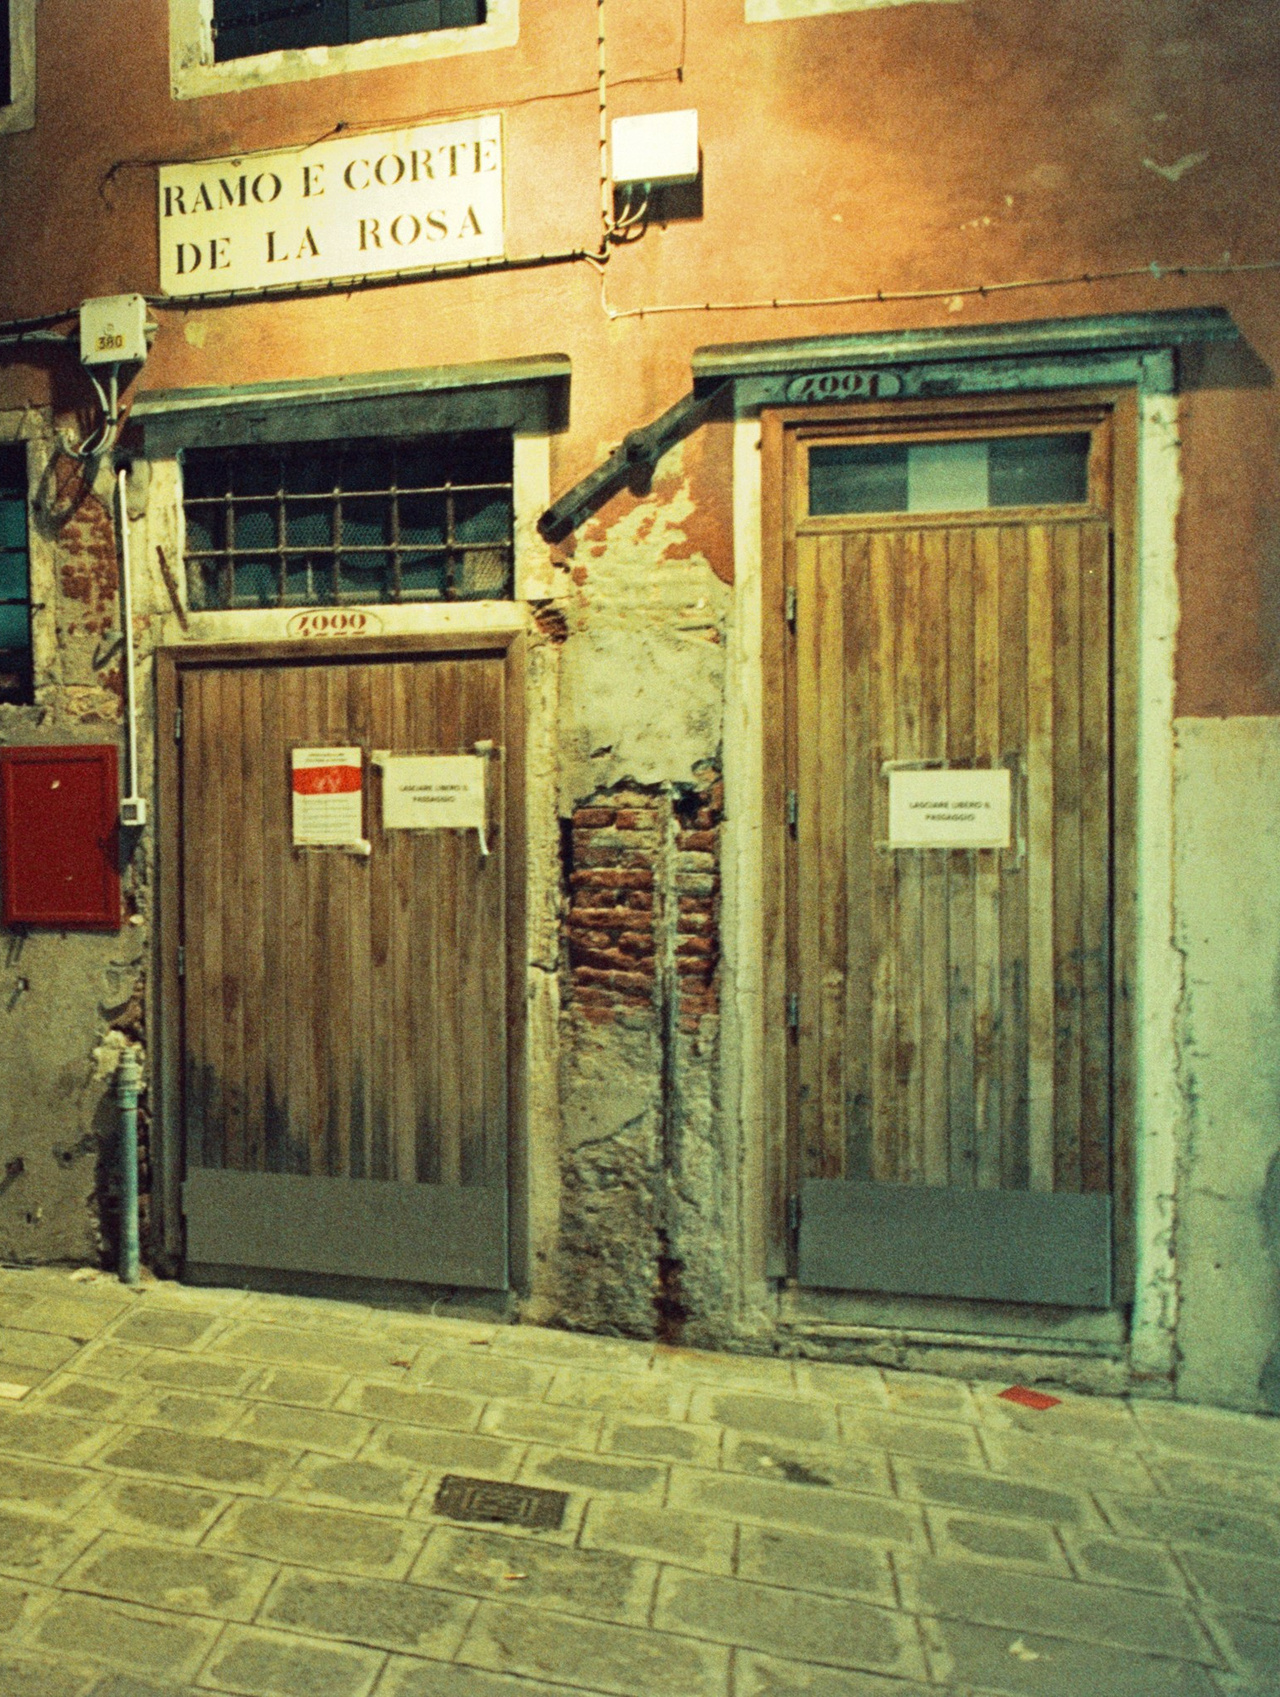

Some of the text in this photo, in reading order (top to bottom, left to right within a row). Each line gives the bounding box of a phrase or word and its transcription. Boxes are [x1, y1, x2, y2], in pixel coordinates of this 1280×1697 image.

[163, 138, 497, 218] RAMO E CORTE
[175, 204, 483, 274] DE LA ROSA
